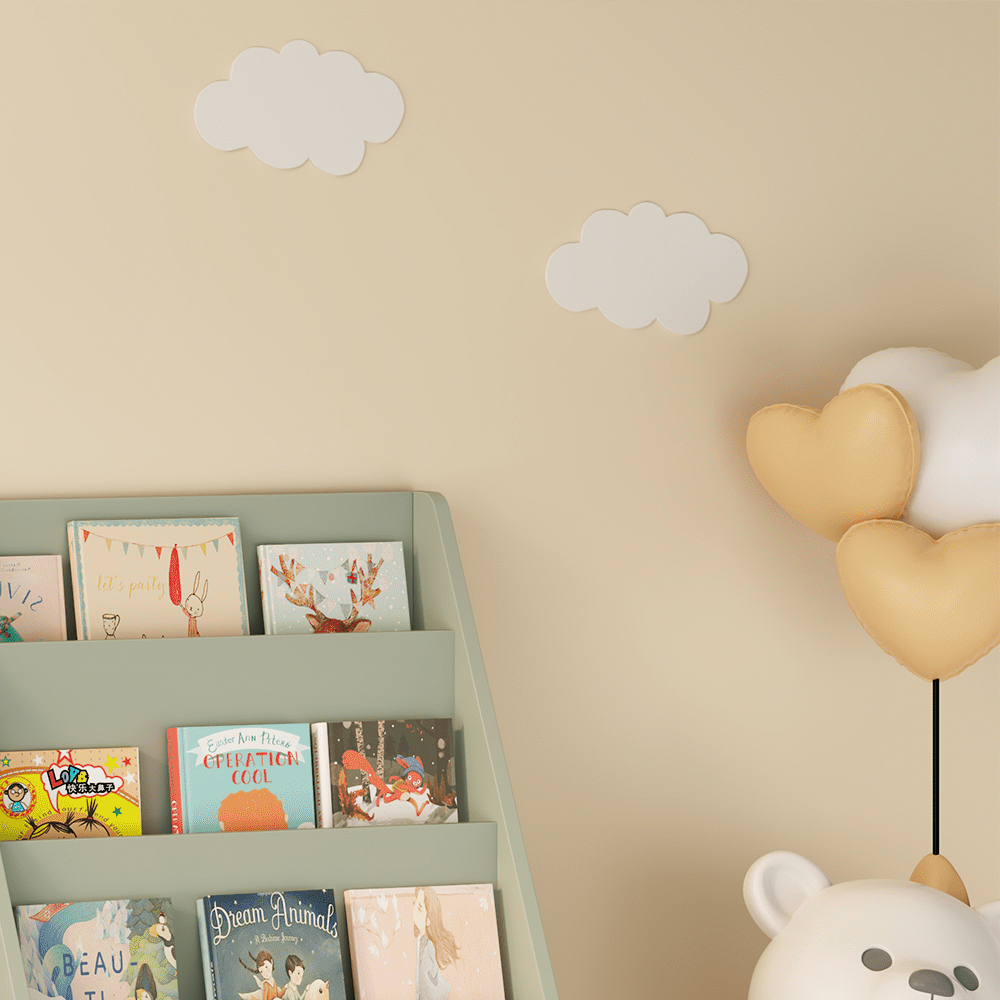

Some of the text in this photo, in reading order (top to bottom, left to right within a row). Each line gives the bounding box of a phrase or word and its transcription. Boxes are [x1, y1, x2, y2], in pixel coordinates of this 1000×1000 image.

[97, 575, 166, 601] let's party
[203, 751, 299, 769] OPERATION
[232, 769, 273, 785] COOL
[210, 891, 338, 946] Dream Animals
[62, 950, 138, 977] BEAU-
